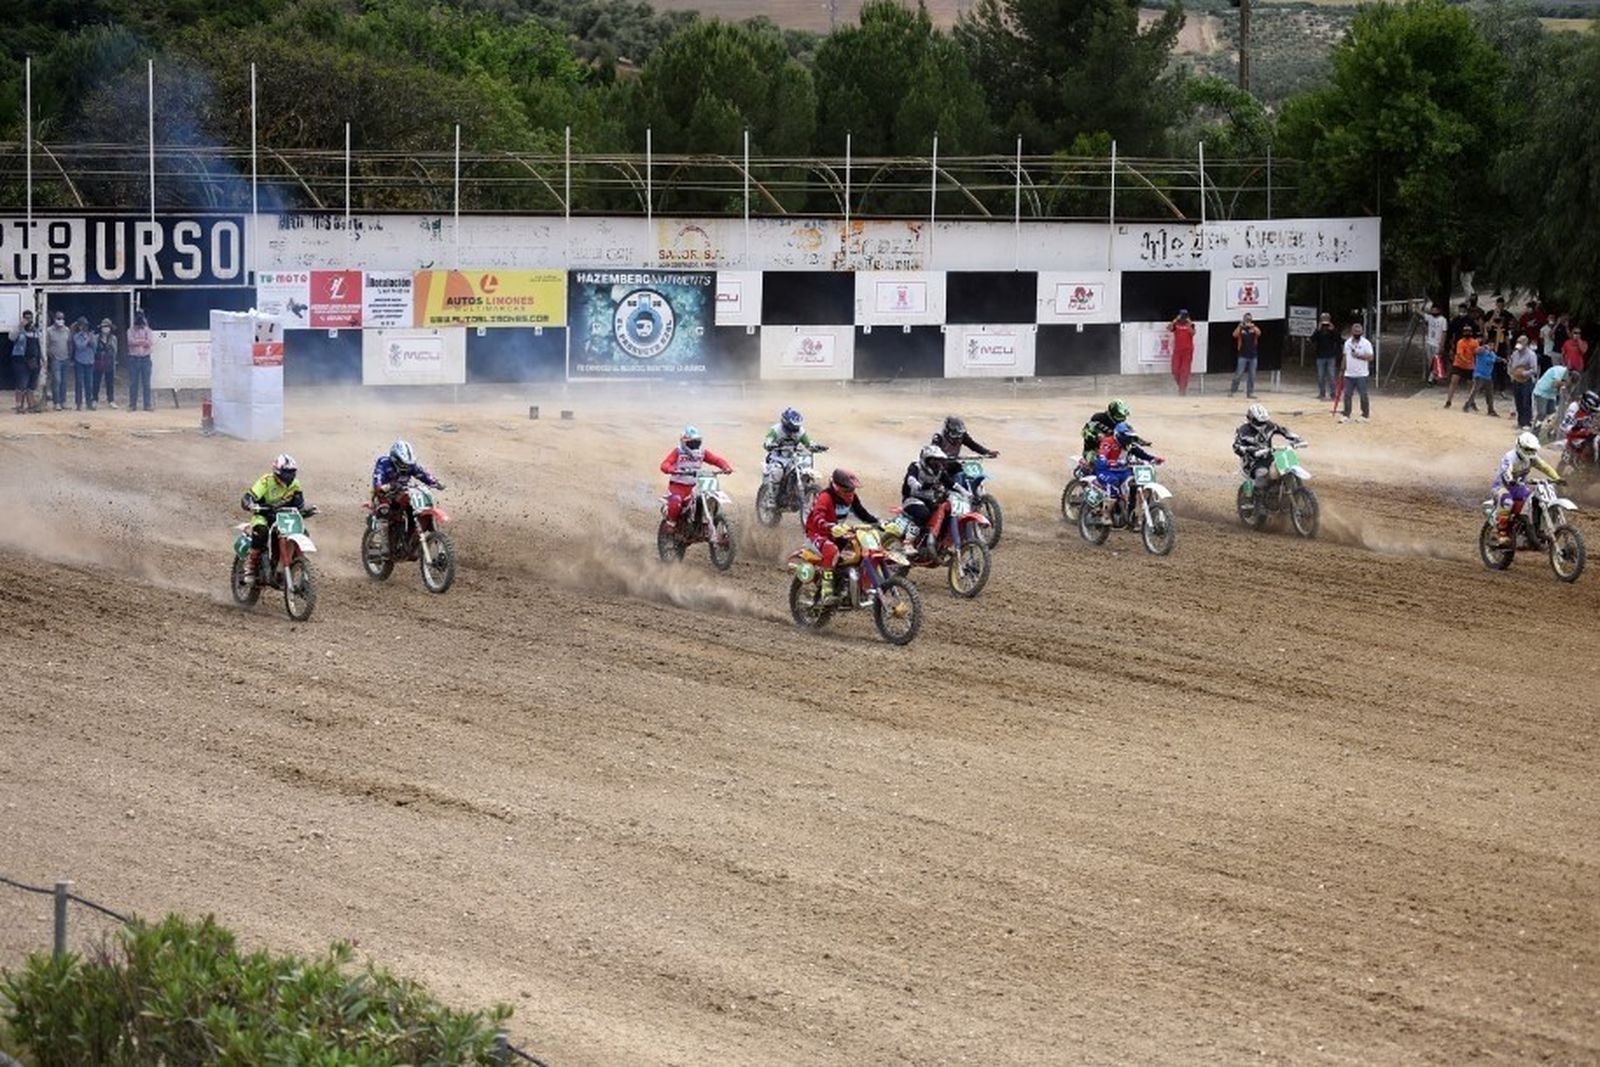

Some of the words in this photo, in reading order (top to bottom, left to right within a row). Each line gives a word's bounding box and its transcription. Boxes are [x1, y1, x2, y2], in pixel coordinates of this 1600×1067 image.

[0, 221, 72, 249] TO
[96, 220, 241, 281] URSO
[0, 253, 72, 280] UB
[447, 296, 483, 305] AUTOS
[485, 296, 534, 305] LIMONES
[284, 519, 295, 533] 7
